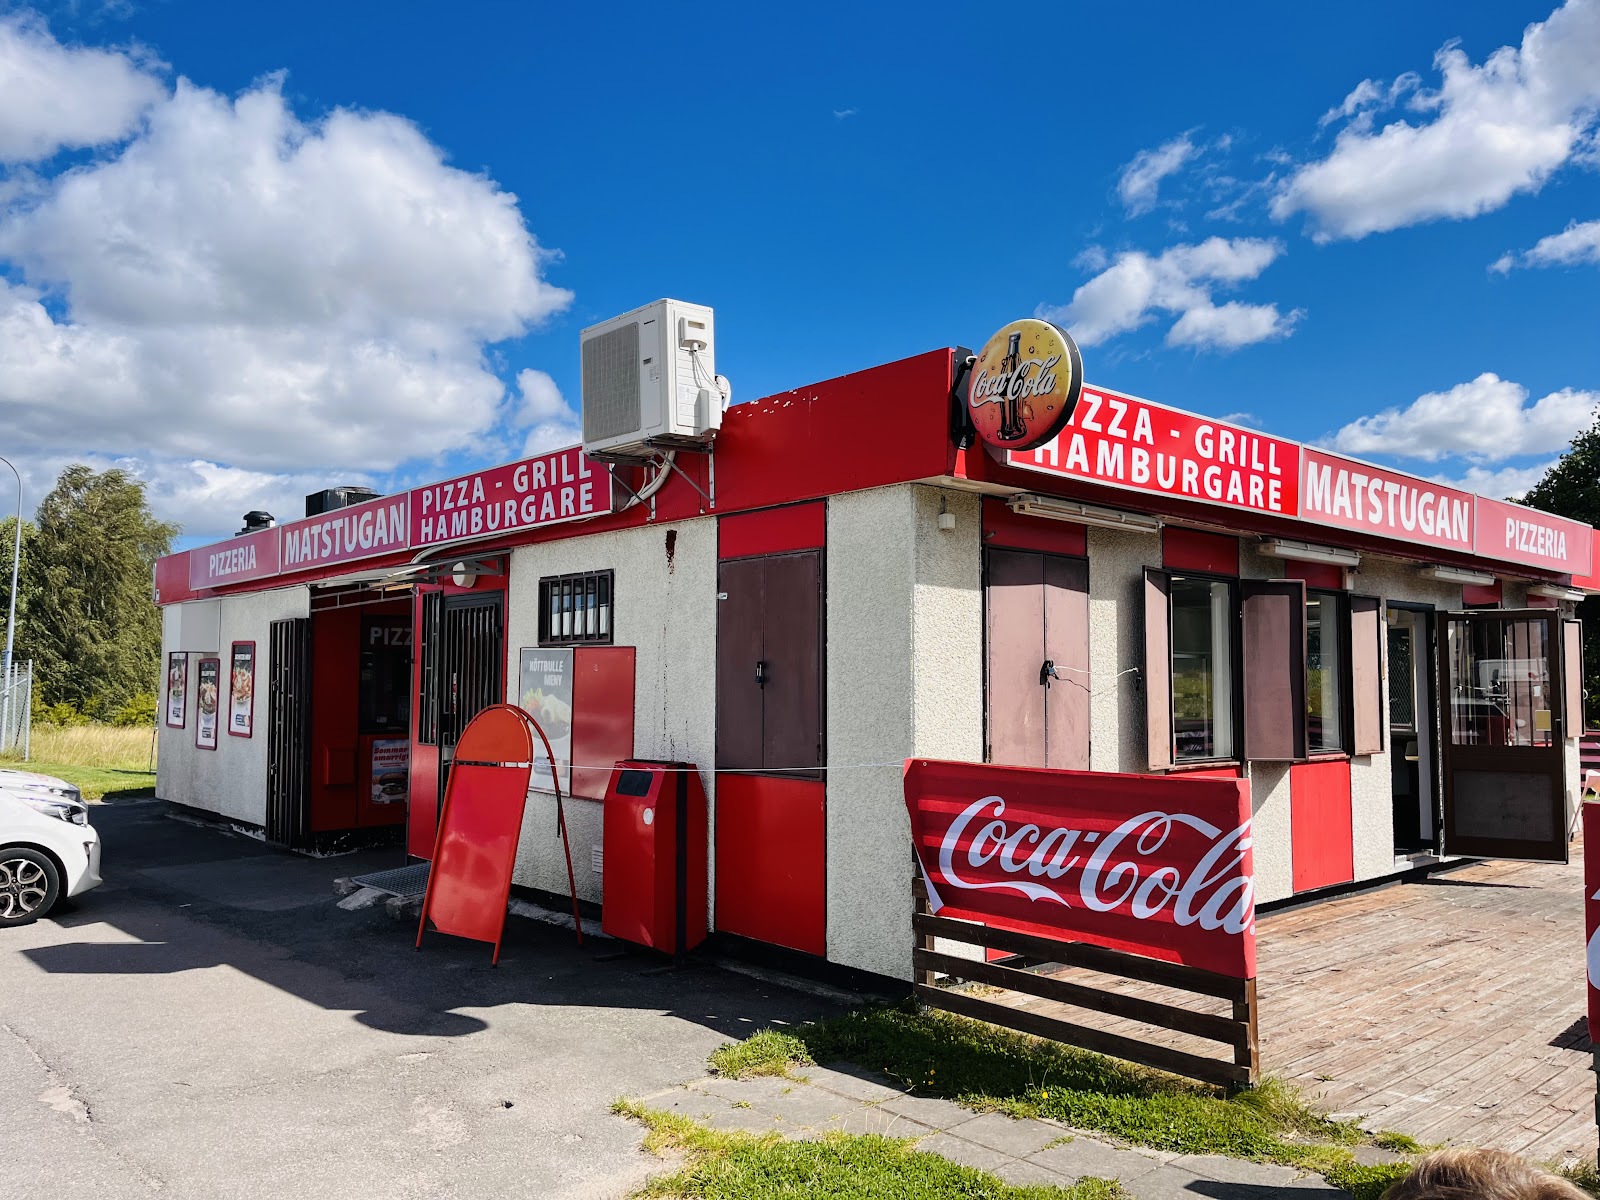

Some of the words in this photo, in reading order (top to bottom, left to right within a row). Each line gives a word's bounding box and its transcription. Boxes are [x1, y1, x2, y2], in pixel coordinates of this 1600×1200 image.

[969, 354, 1061, 408] Coca-Cola
[1066, 392, 1154, 445] ZZA
[1194, 424, 1281, 475] GRILL
[422, 476, 485, 513] PIZZA
[513, 451, 592, 493] GRILL
[1034, 433, 1281, 511] HAMBURGARE
[1306, 461, 1469, 543] MATSTUGAN
[285, 502, 405, 565] MATSTUGAN
[421, 482, 593, 543] HAMBURGARE
[1505, 517, 1567, 560] PIZZERIA
[209, 543, 257, 578] PIZZERIA
[544, 674, 562, 687] MENY
[939, 795, 1254, 935] Coca-Cola
